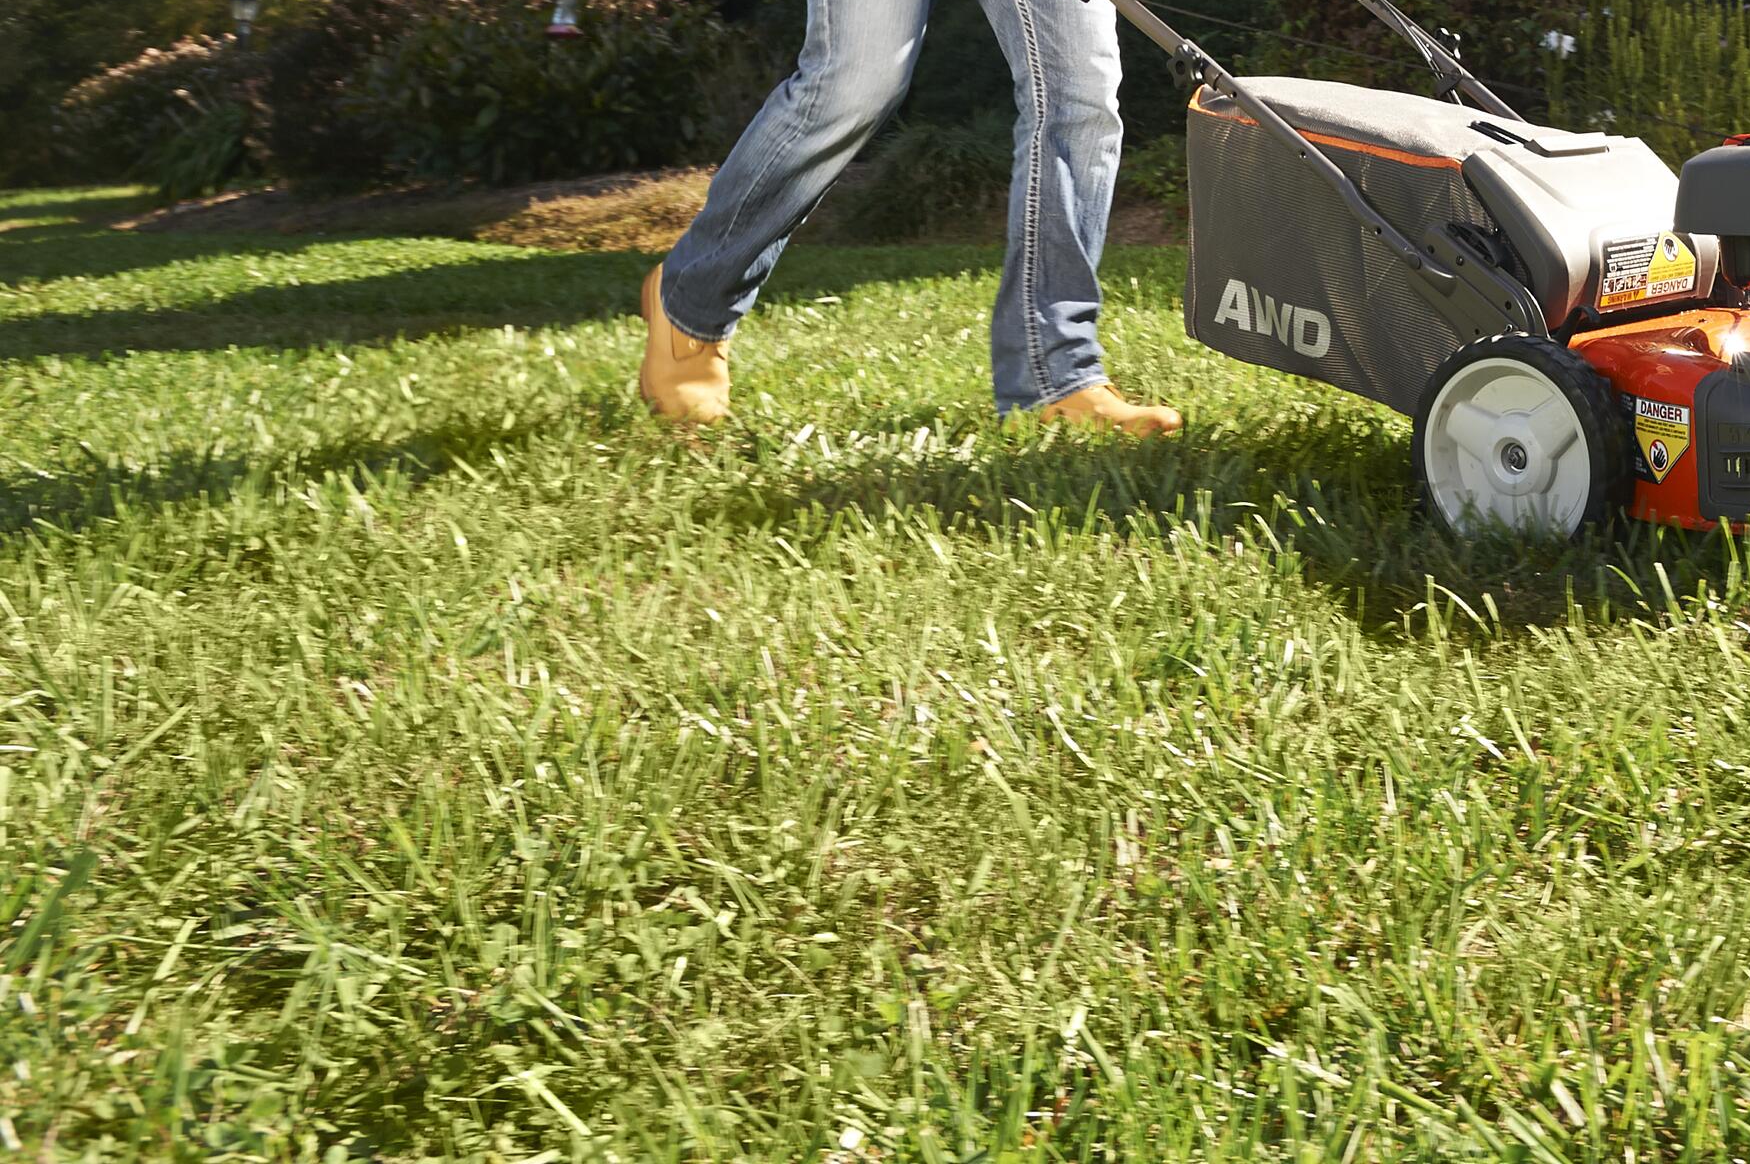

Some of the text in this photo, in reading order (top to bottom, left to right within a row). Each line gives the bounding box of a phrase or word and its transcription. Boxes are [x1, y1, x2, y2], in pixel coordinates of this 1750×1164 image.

[1652, 279, 1687, 294] DANGER
[1213, 278, 1332, 358] AWD
[1640, 400, 1683, 422] DANGER
